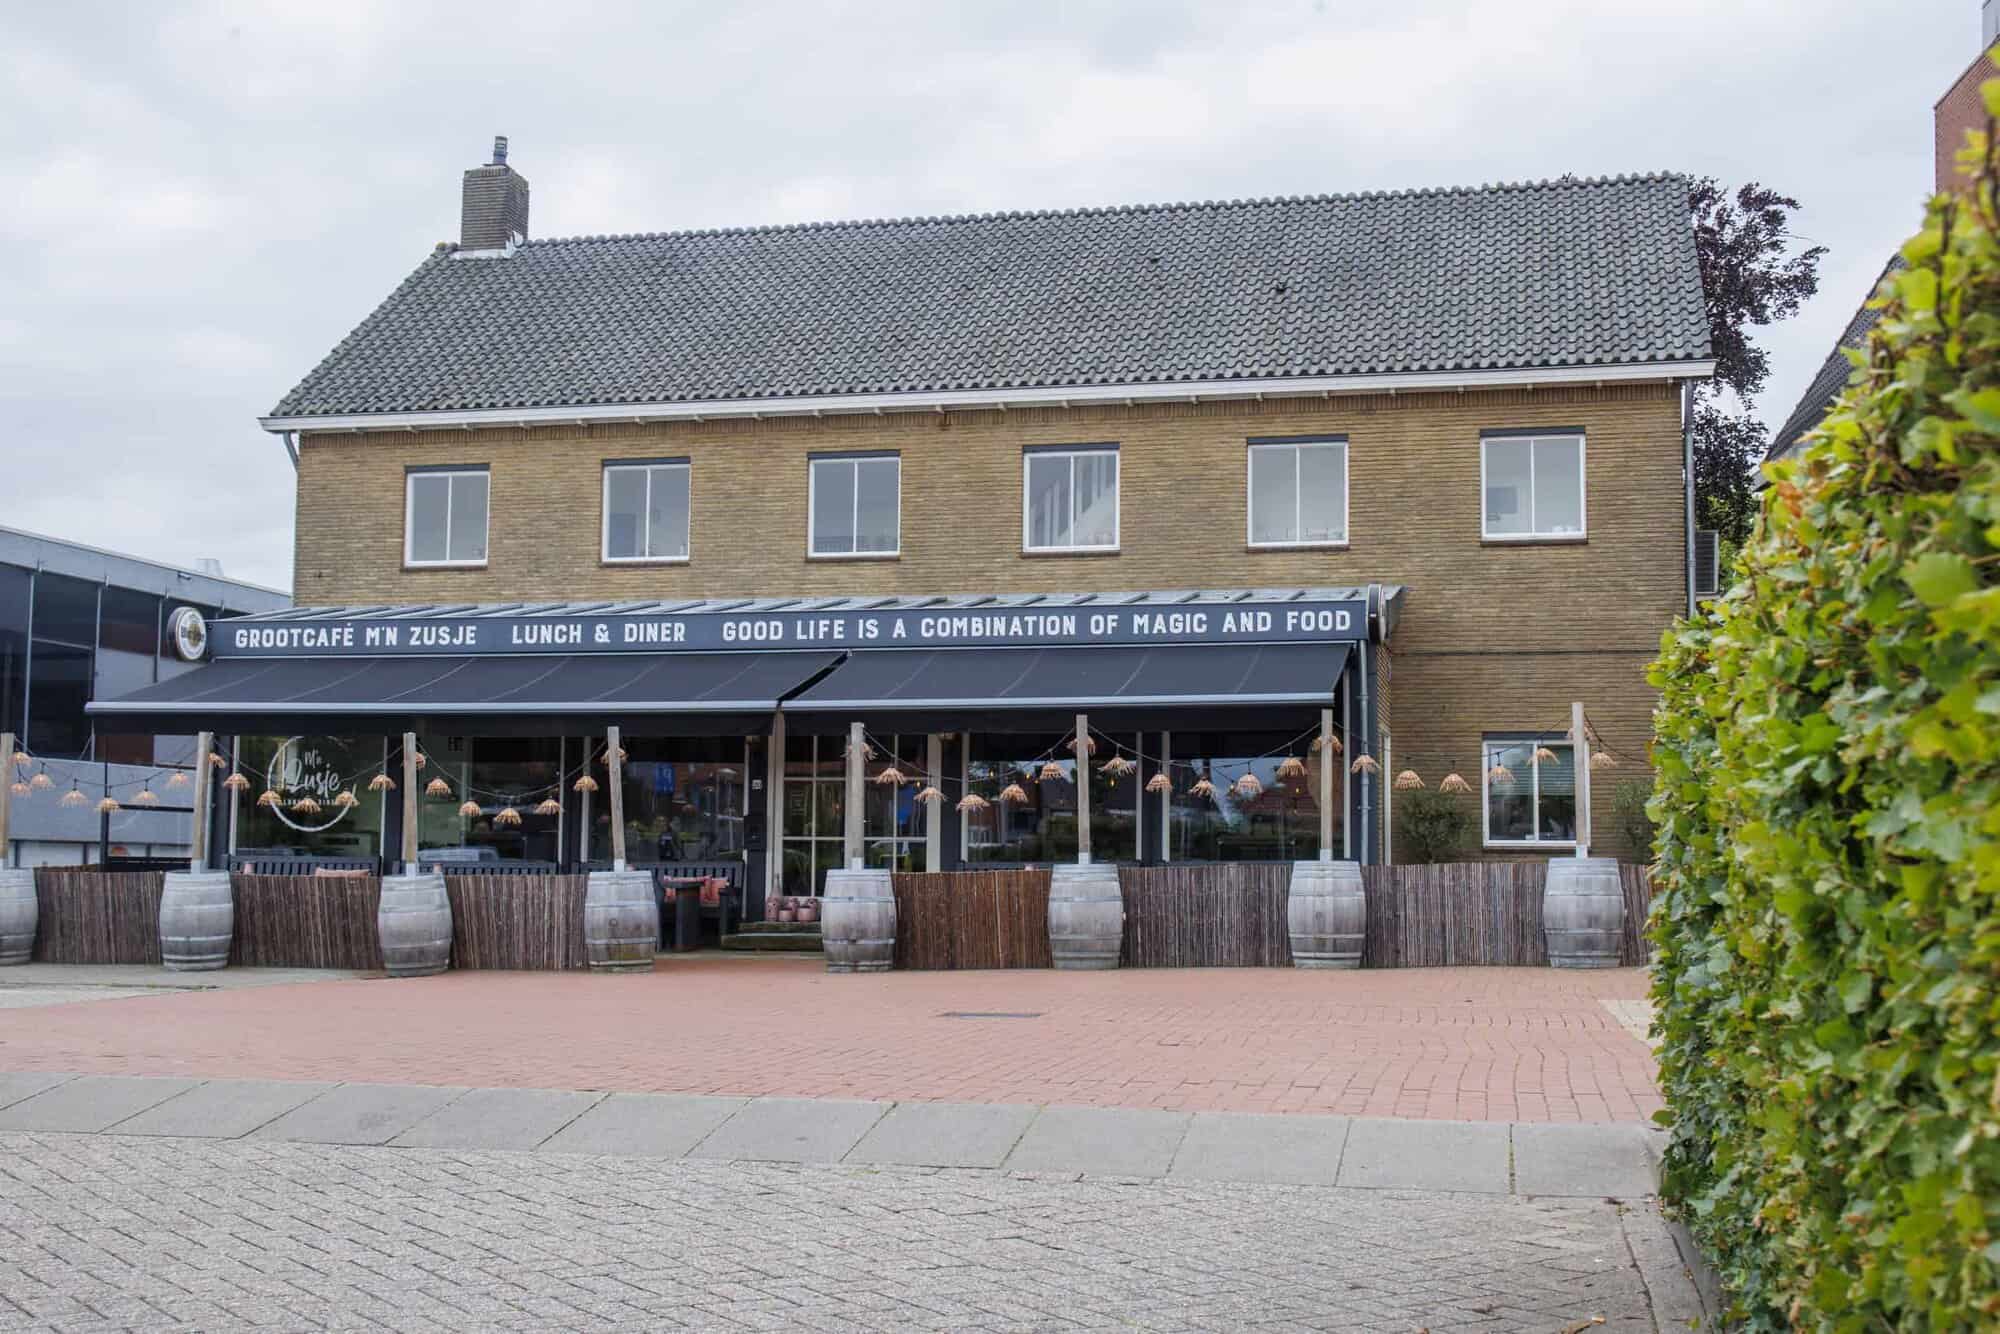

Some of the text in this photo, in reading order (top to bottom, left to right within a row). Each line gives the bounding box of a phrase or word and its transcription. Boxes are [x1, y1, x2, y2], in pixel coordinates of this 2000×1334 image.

[235, 622, 478, 649] GROOTCAFÉ M'N ZUSJE
[511, 621, 686, 645] LUNCH & DINER
[722, 610, 1351, 642] GOOD LIFE IS A COMBINATION OF MAGIC AND FOOD
